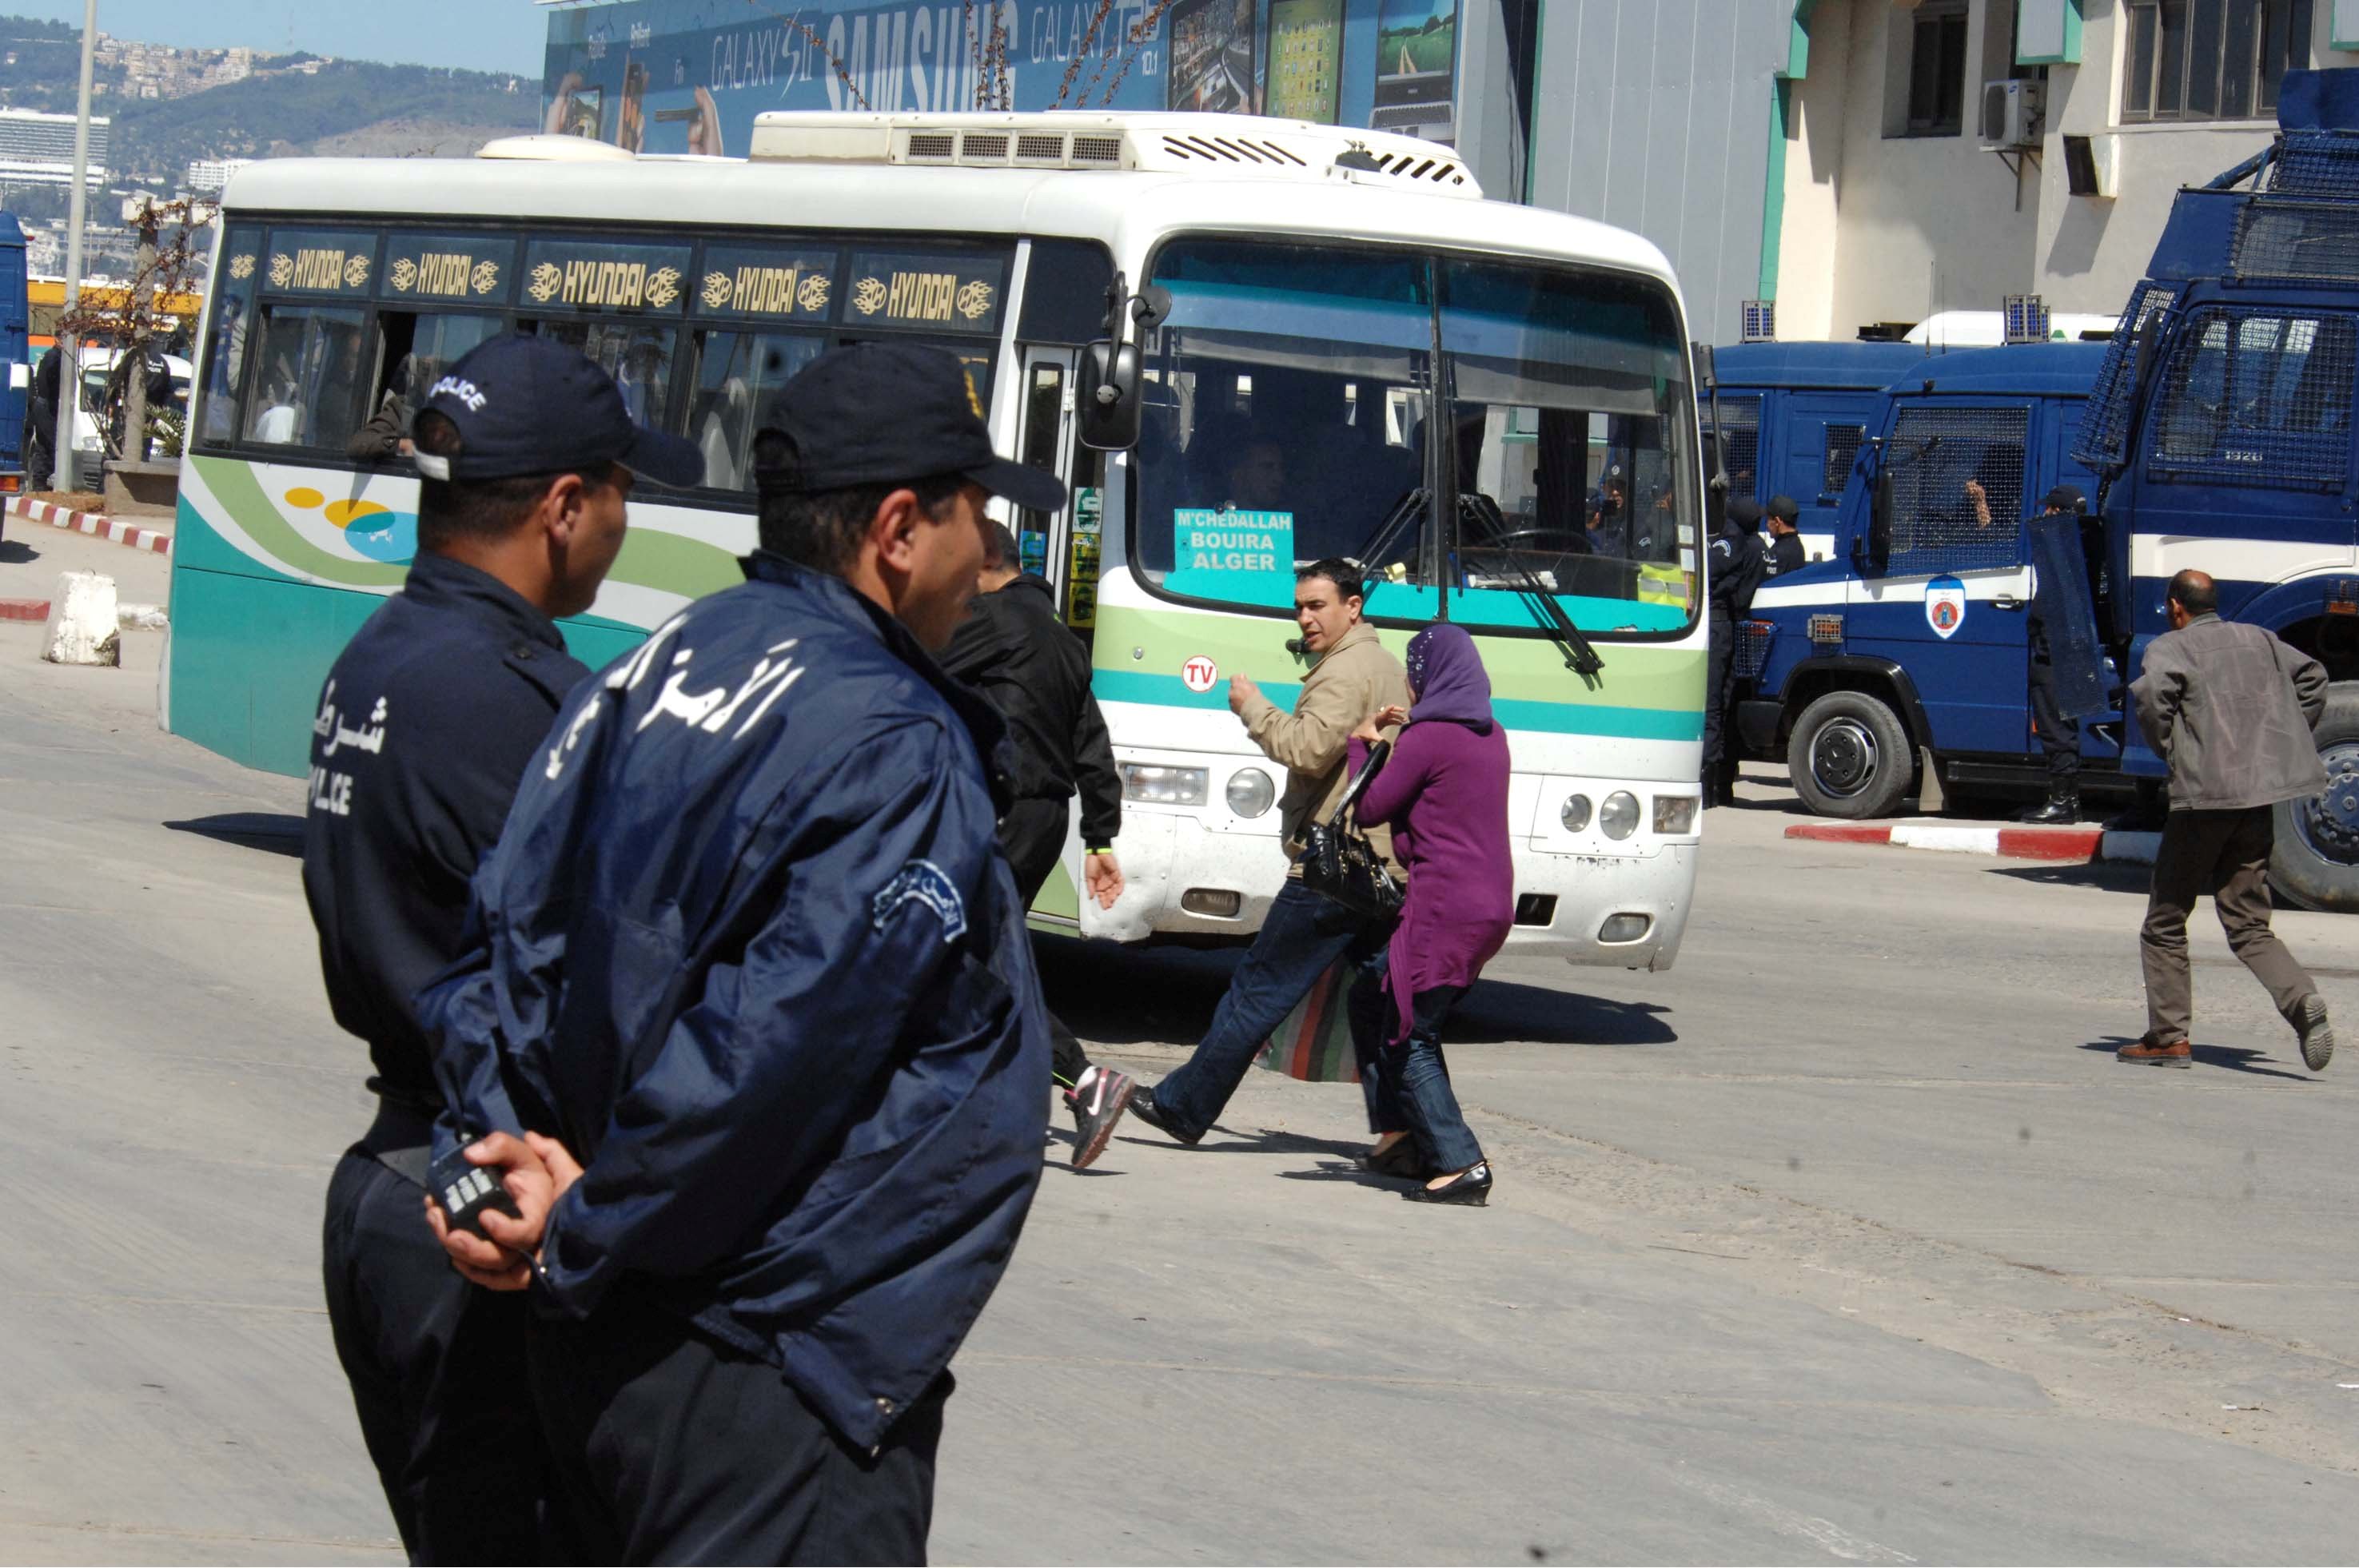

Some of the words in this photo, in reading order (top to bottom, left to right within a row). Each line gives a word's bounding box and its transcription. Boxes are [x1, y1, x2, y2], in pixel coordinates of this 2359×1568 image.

[1031, 1, 1110, 64] GALAXY
[711, 29, 779, 91] GALAXY
[825, 0, 1018, 111] SAMSUNG
[1142, 50, 1158, 77] 10.1
[293, 249, 345, 289] HYUNDAI
[416, 253, 472, 296] HYUNDAI
[562, 261, 646, 306] HYUNDAI
[732, 267, 797, 312] HYUNDAI
[887, 272, 956, 320] HYUNDAI
[1178, 511, 1291, 531] M'CHEDALLAH
[1191, 532, 1274, 551] BOUIRA
[1193, 552, 1276, 571] ALGER
[1187, 664, 1213, 684] TV
